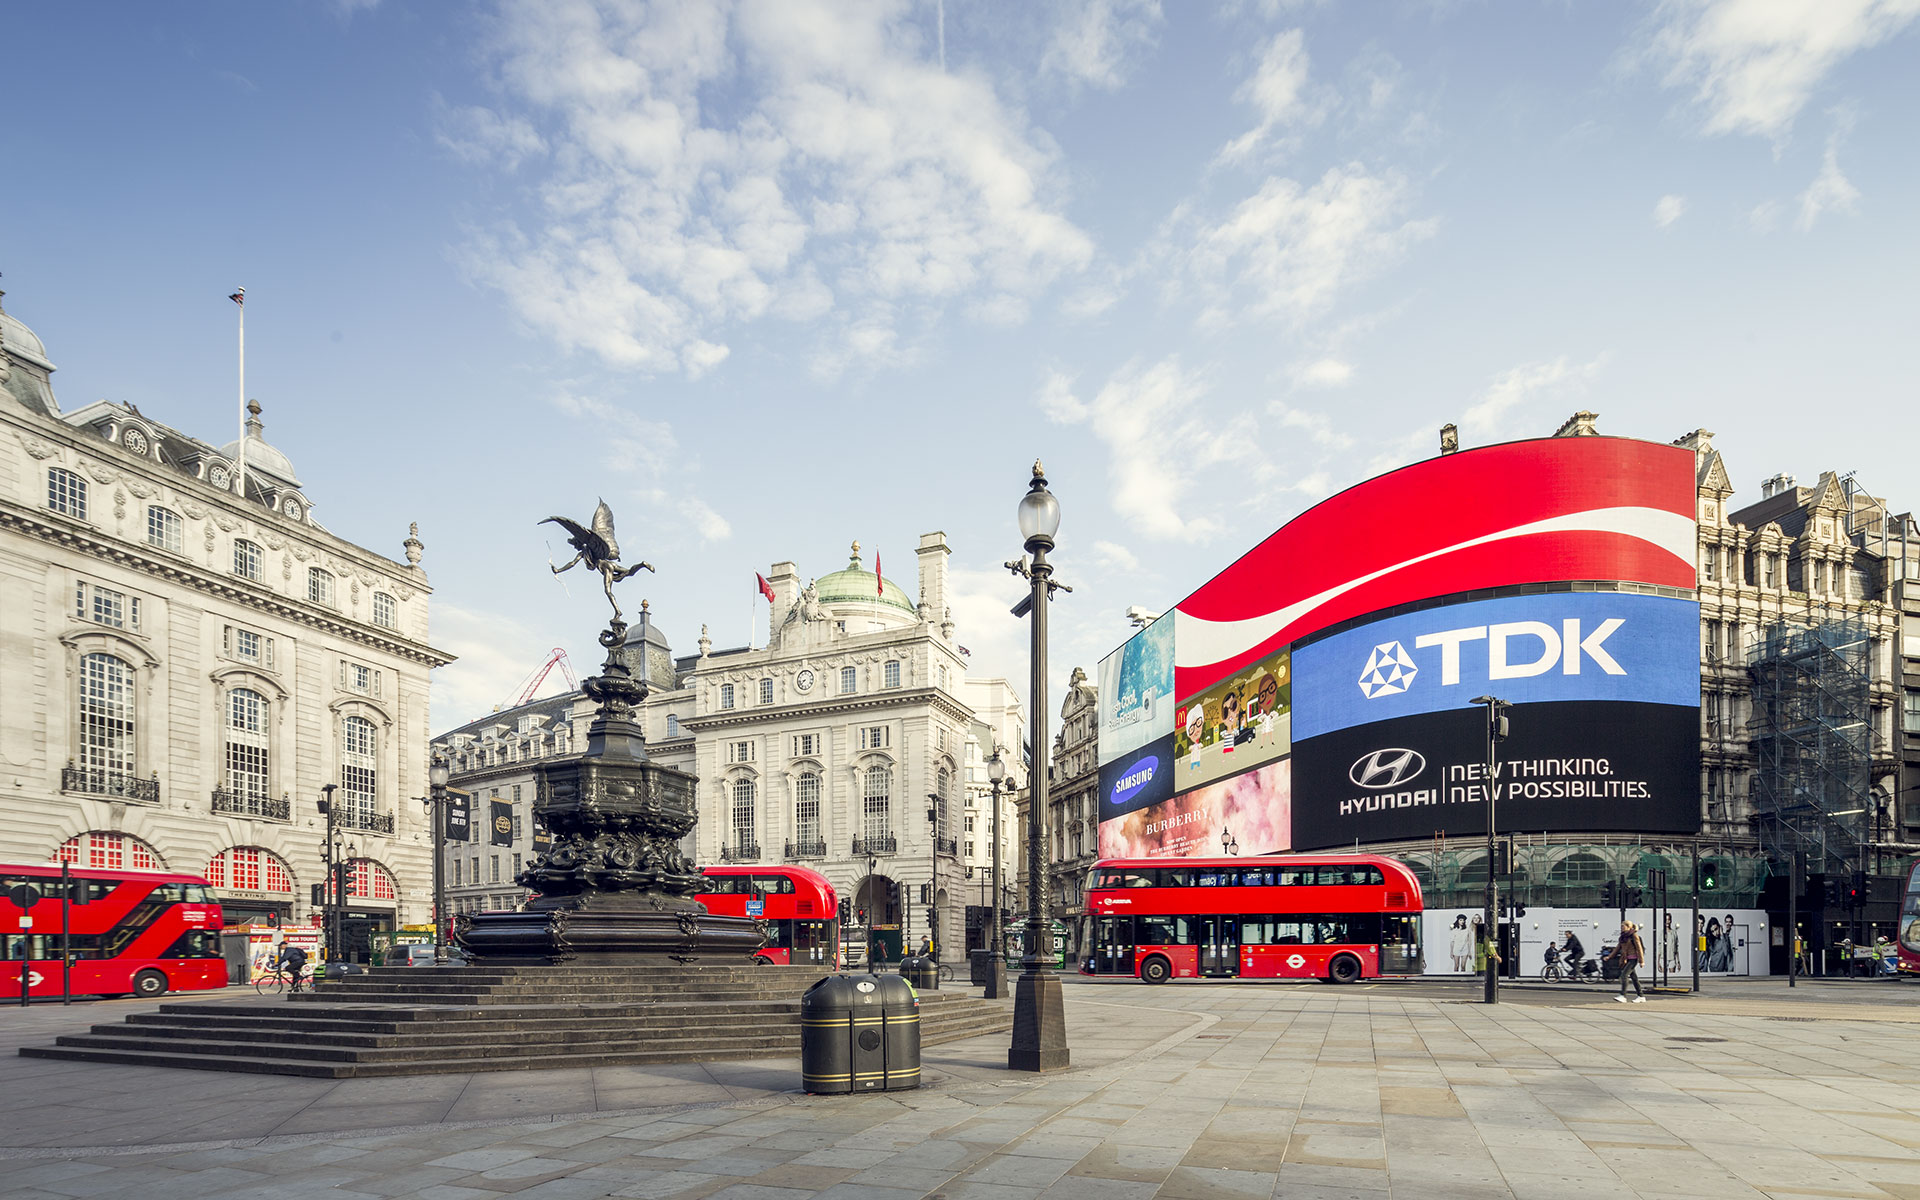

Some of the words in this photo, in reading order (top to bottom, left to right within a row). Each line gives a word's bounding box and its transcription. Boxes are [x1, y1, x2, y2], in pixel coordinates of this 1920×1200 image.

[1416, 618, 1628, 686] TDK
[1115, 767, 1153, 794] SAMSUNG
[1451, 761, 1502, 782] NEW
[1507, 758, 1614, 777] THINKING.
[1340, 789, 1436, 815] HYUNDAI
[1451, 783, 1502, 803] NEW
[1509, 780, 1651, 800] POSSIBILITIES.
[1146, 808, 1208, 835] BURBERRY
